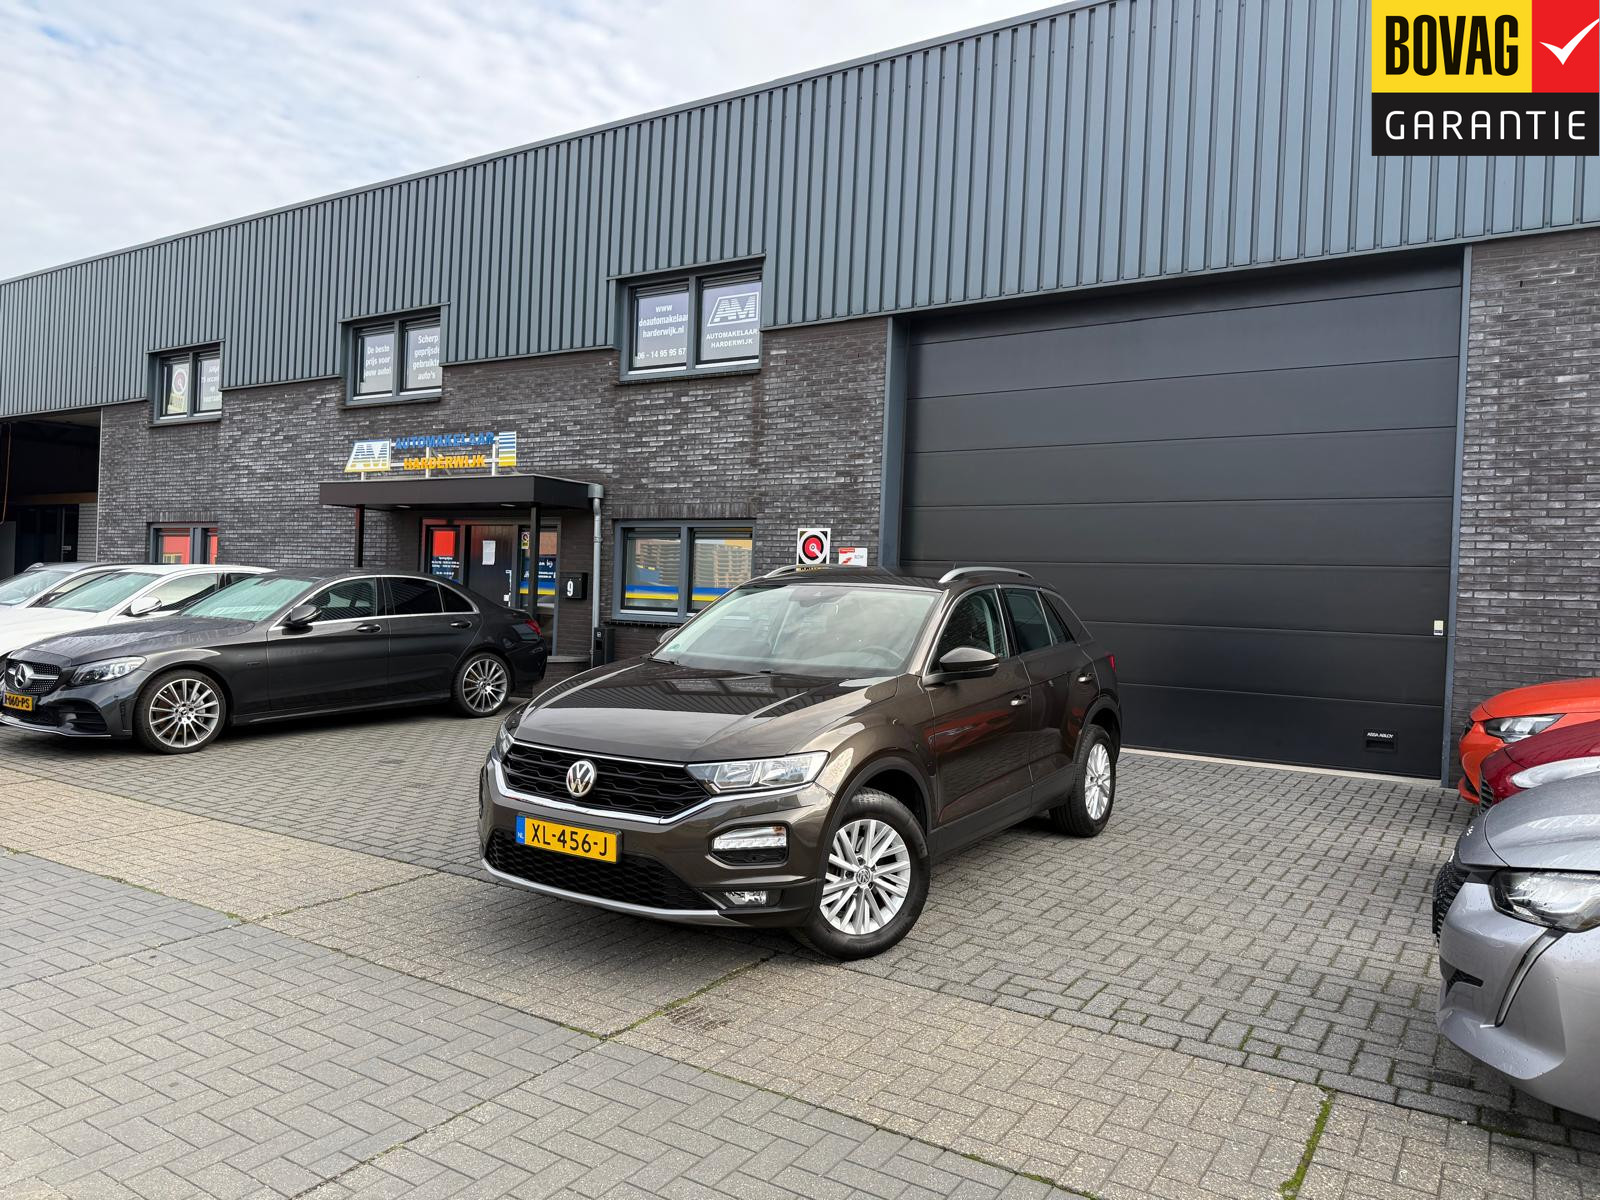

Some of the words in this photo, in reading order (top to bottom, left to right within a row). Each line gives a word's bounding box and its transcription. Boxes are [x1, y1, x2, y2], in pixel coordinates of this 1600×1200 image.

[655, 304, 673, 312] www
[417, 335, 439, 344] Scherp
[705, 329, 759, 340] AUTOMAKELAAR
[711, 338, 753, 349] HARDERWIJK
[375, 345, 390, 354] beste
[651, 350, 659, 359] 14
[660, 349, 668, 358] 95
[669, 348, 677, 357] 95
[365, 357, 378, 367] prijs
[379, 356, 391, 364] voor
[417, 371, 436, 380] auto's
[395, 432, 495, 450] AUTOMAKELAAR
[403, 454, 486, 471] HARDERWIJK
[567, 580, 574, 596] 9
[517, 831, 525, 839] NL
[531, 823, 608, 857] XL-456-J
